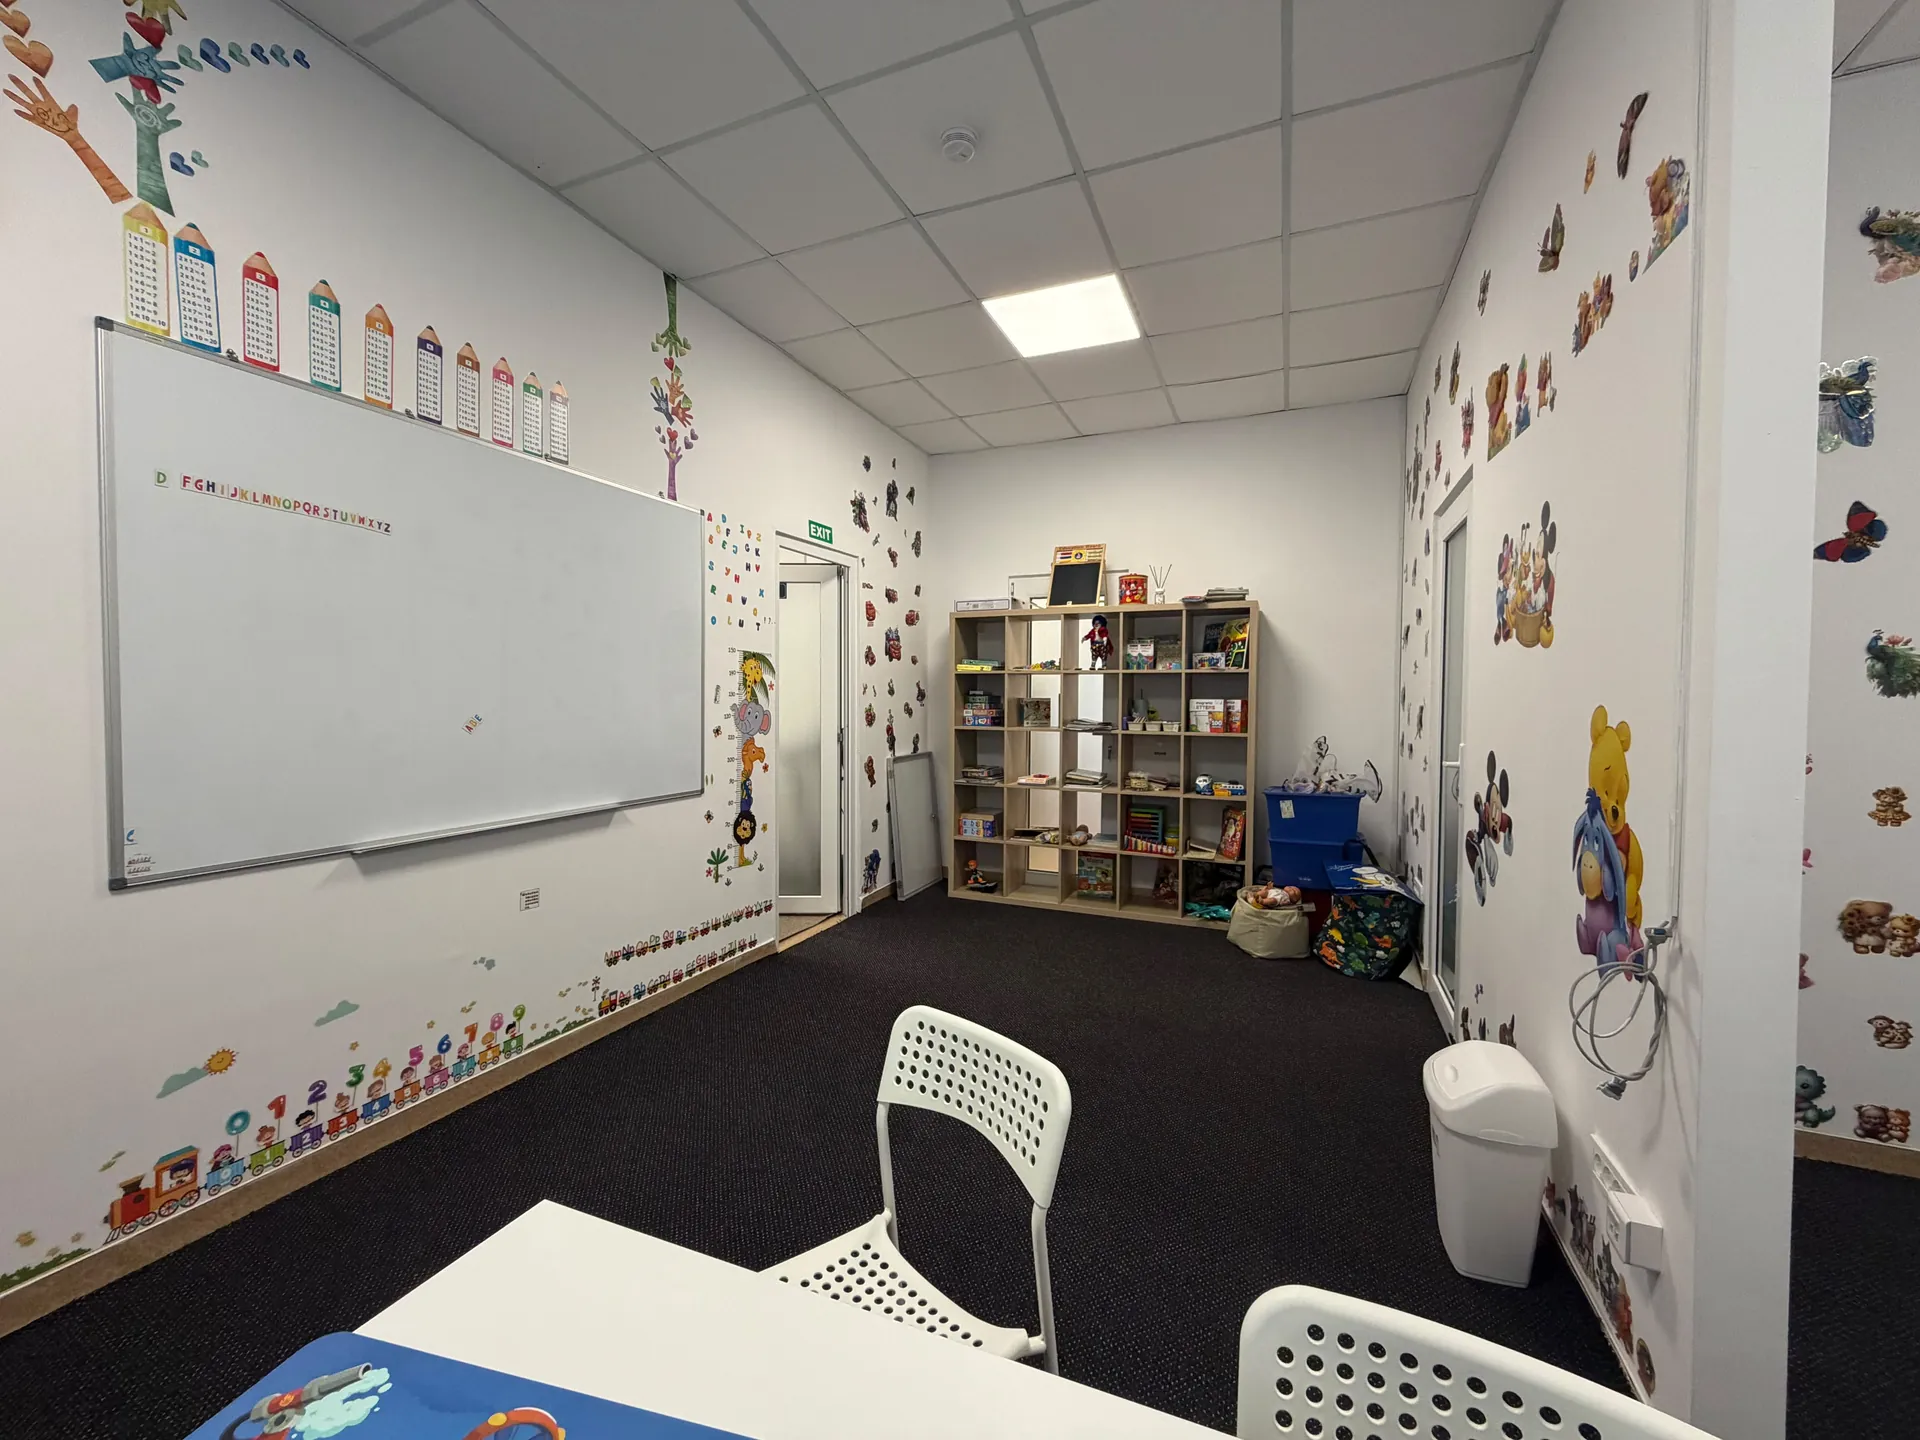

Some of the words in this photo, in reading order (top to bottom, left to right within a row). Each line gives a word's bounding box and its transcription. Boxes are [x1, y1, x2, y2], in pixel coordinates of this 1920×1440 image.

[156, 472, 166, 484] D
[707, 512, 712, 522] A
[726, 528, 730, 537] F
[811, 524, 831, 540] EXIT
[722, 540, 727, 550] E
[755, 548, 760, 557] K
[708, 561, 714, 570] S
[710, 585, 716, 595] R
[759, 588, 764, 598] X
[756, 622, 760, 631] T
[513, 1004, 526, 1021] 9
[490, 1013, 503, 1031] 8
[464, 1022, 478, 1043] 7
[437, 1034, 452, 1054] 6
[408, 1044, 423, 1066] 5
[373, 1057, 392, 1078] 4
[346, 1064, 366, 1087] 3
[433, 1075, 440, 1083] 6
[308, 1080, 327, 1105] 2
[268, 1094, 286, 1119] 1
[373, 1102, 380, 1111] 4
[226, 1110, 250, 1136] 0
[302, 1133, 311, 1143] 2
[265, 1149, 270, 1160] 1
